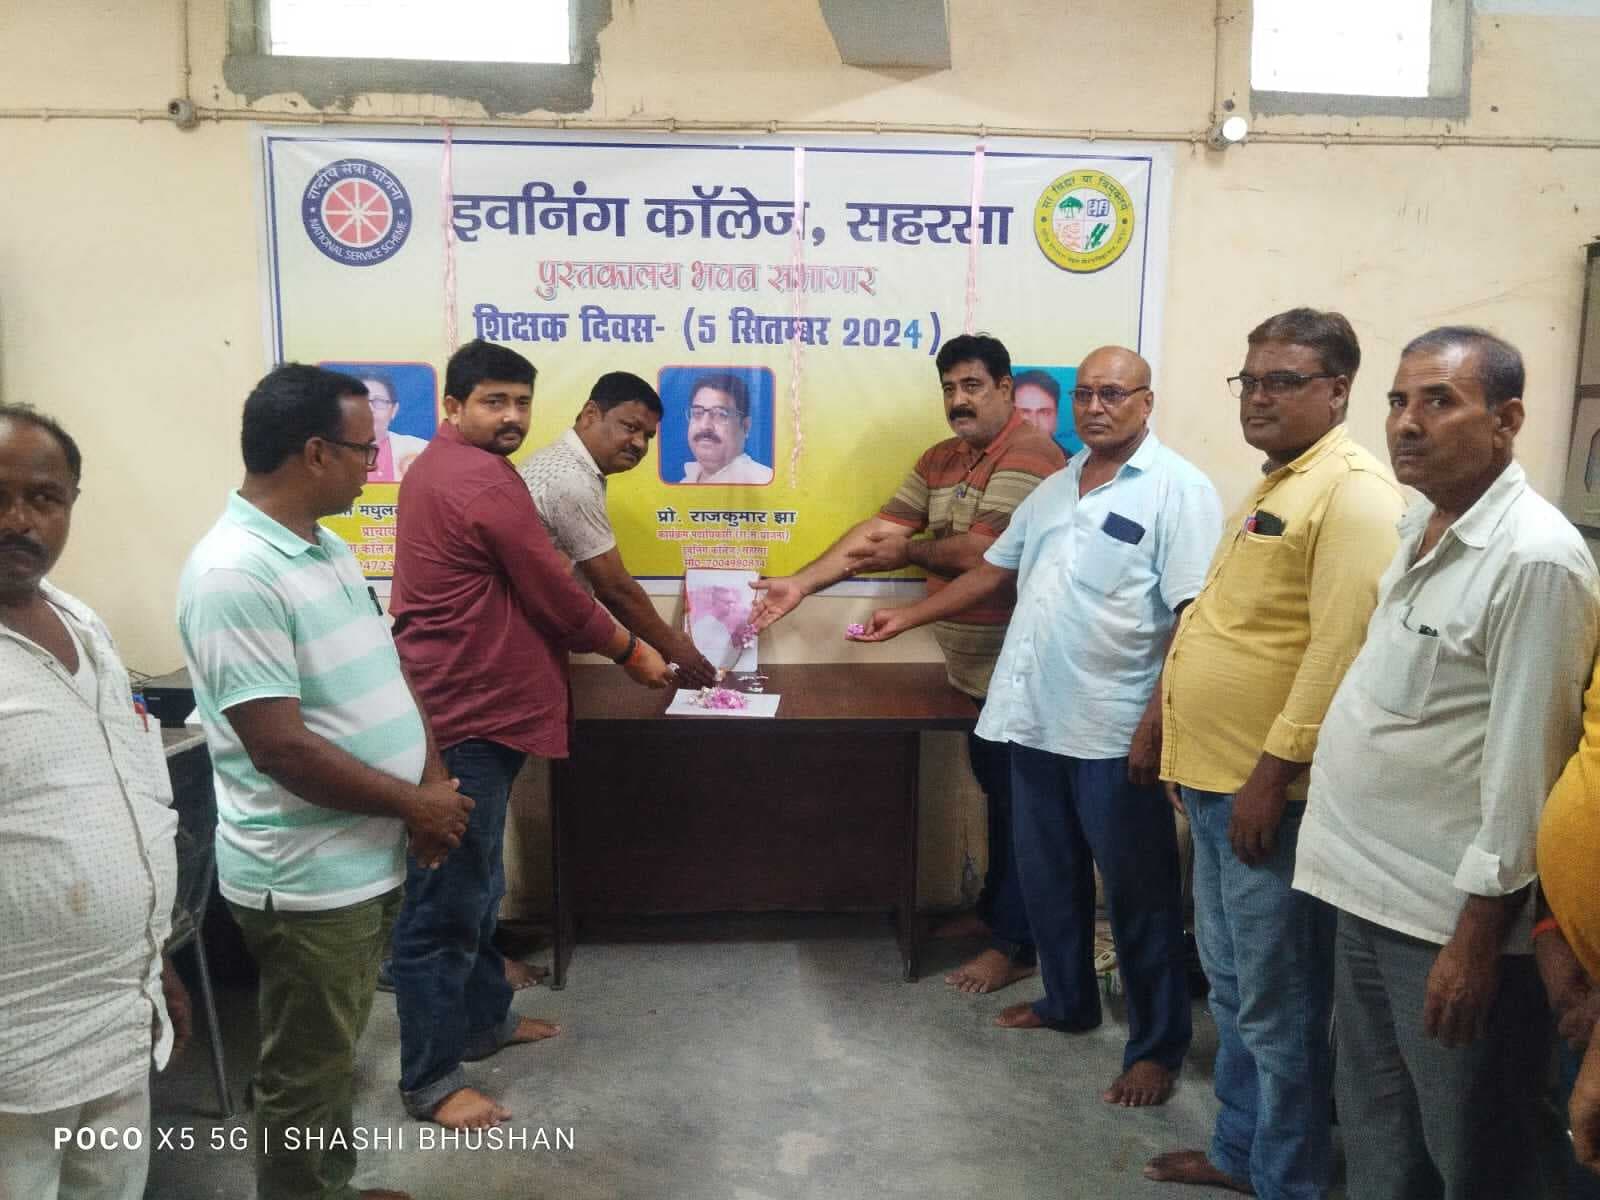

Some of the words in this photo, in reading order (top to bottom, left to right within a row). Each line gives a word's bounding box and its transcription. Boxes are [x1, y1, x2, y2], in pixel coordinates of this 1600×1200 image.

[452, 180, 630, 242] इवनिंग
[644, 185, 826, 247] कॉलेज,
[846, 202, 1015, 246] सहरसा
[310, 218, 344, 257] NATIONAL
[345, 248, 382, 261] SERVICE
[381, 220, 409, 254] SCHEME
[534, 259, 683, 301] पुस्तकालय
[691, 260, 760, 293] भवन
[472, 303, 570, 342] शिक्षक
[728, 306, 832, 346] सितम्बर
[656, 507, 682, 524] प्रो.
[689, 510, 768, 527] राजकुमार
[774, 510, 797, 524] झा
